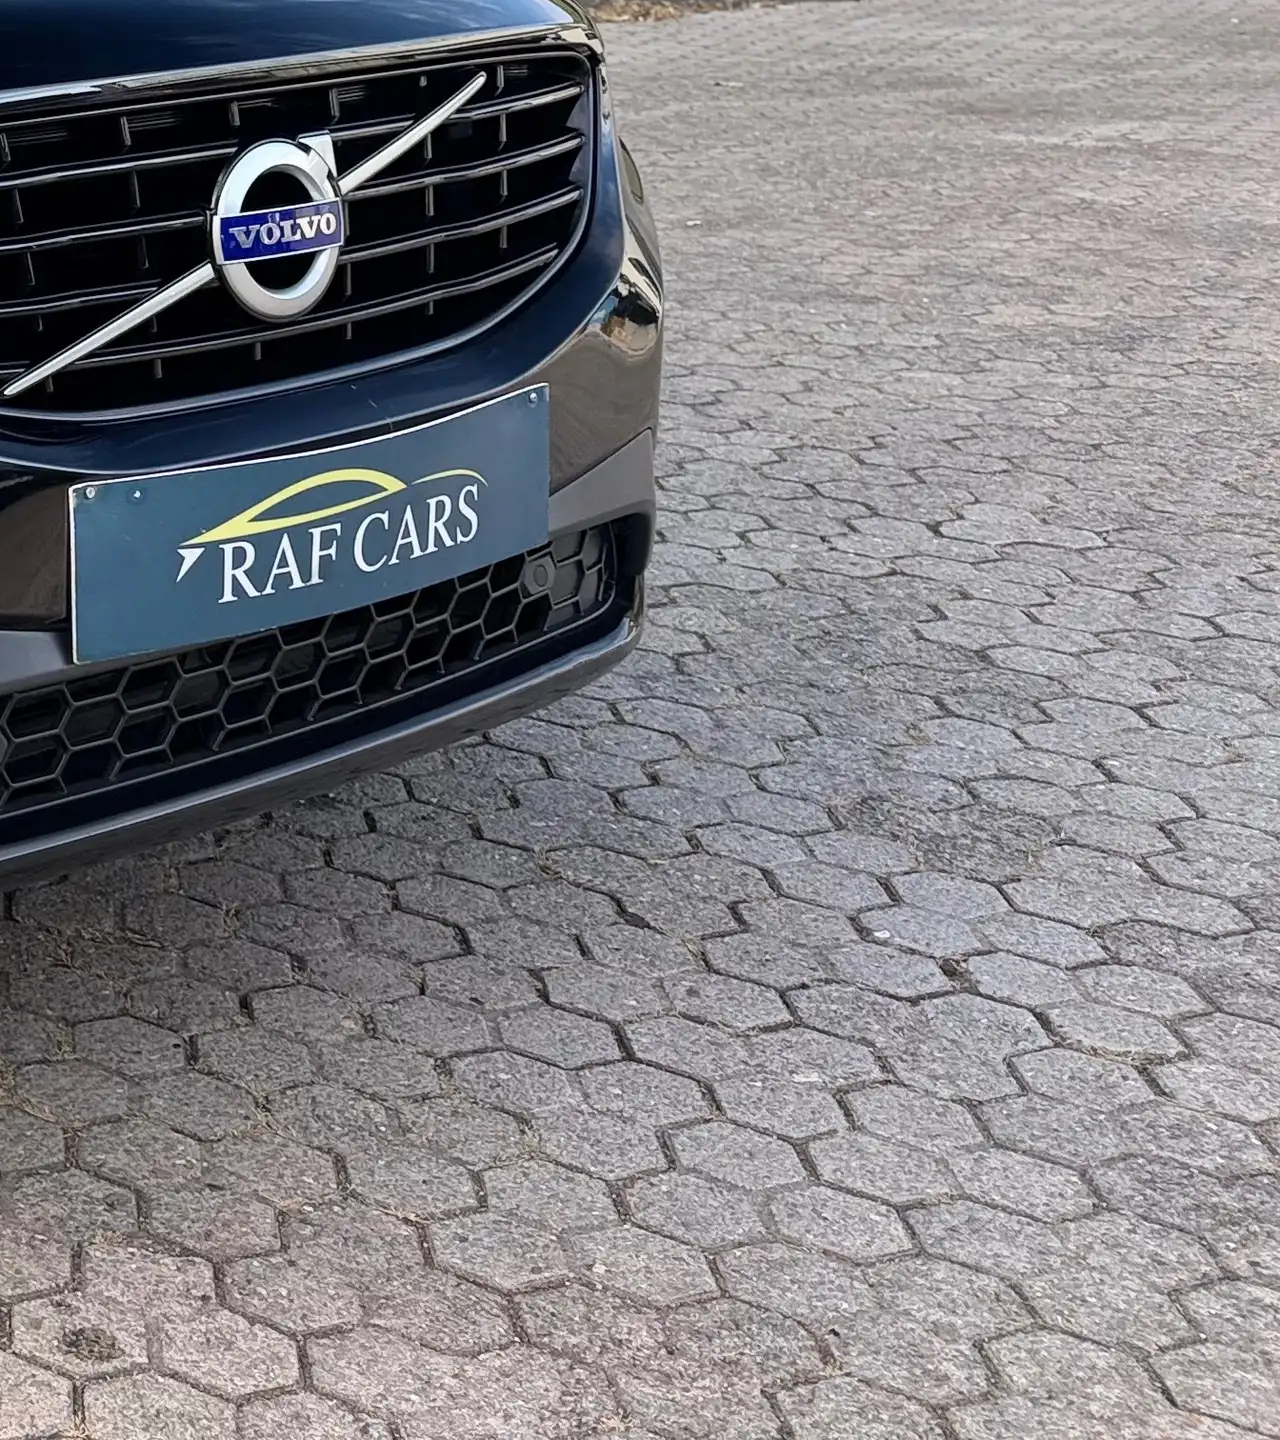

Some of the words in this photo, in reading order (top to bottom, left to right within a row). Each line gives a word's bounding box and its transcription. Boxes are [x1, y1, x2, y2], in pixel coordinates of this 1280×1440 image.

[228, 212, 337, 249] VOLVO
[218, 522, 341, 605] RAF
[353, 482, 481, 574] CARS
